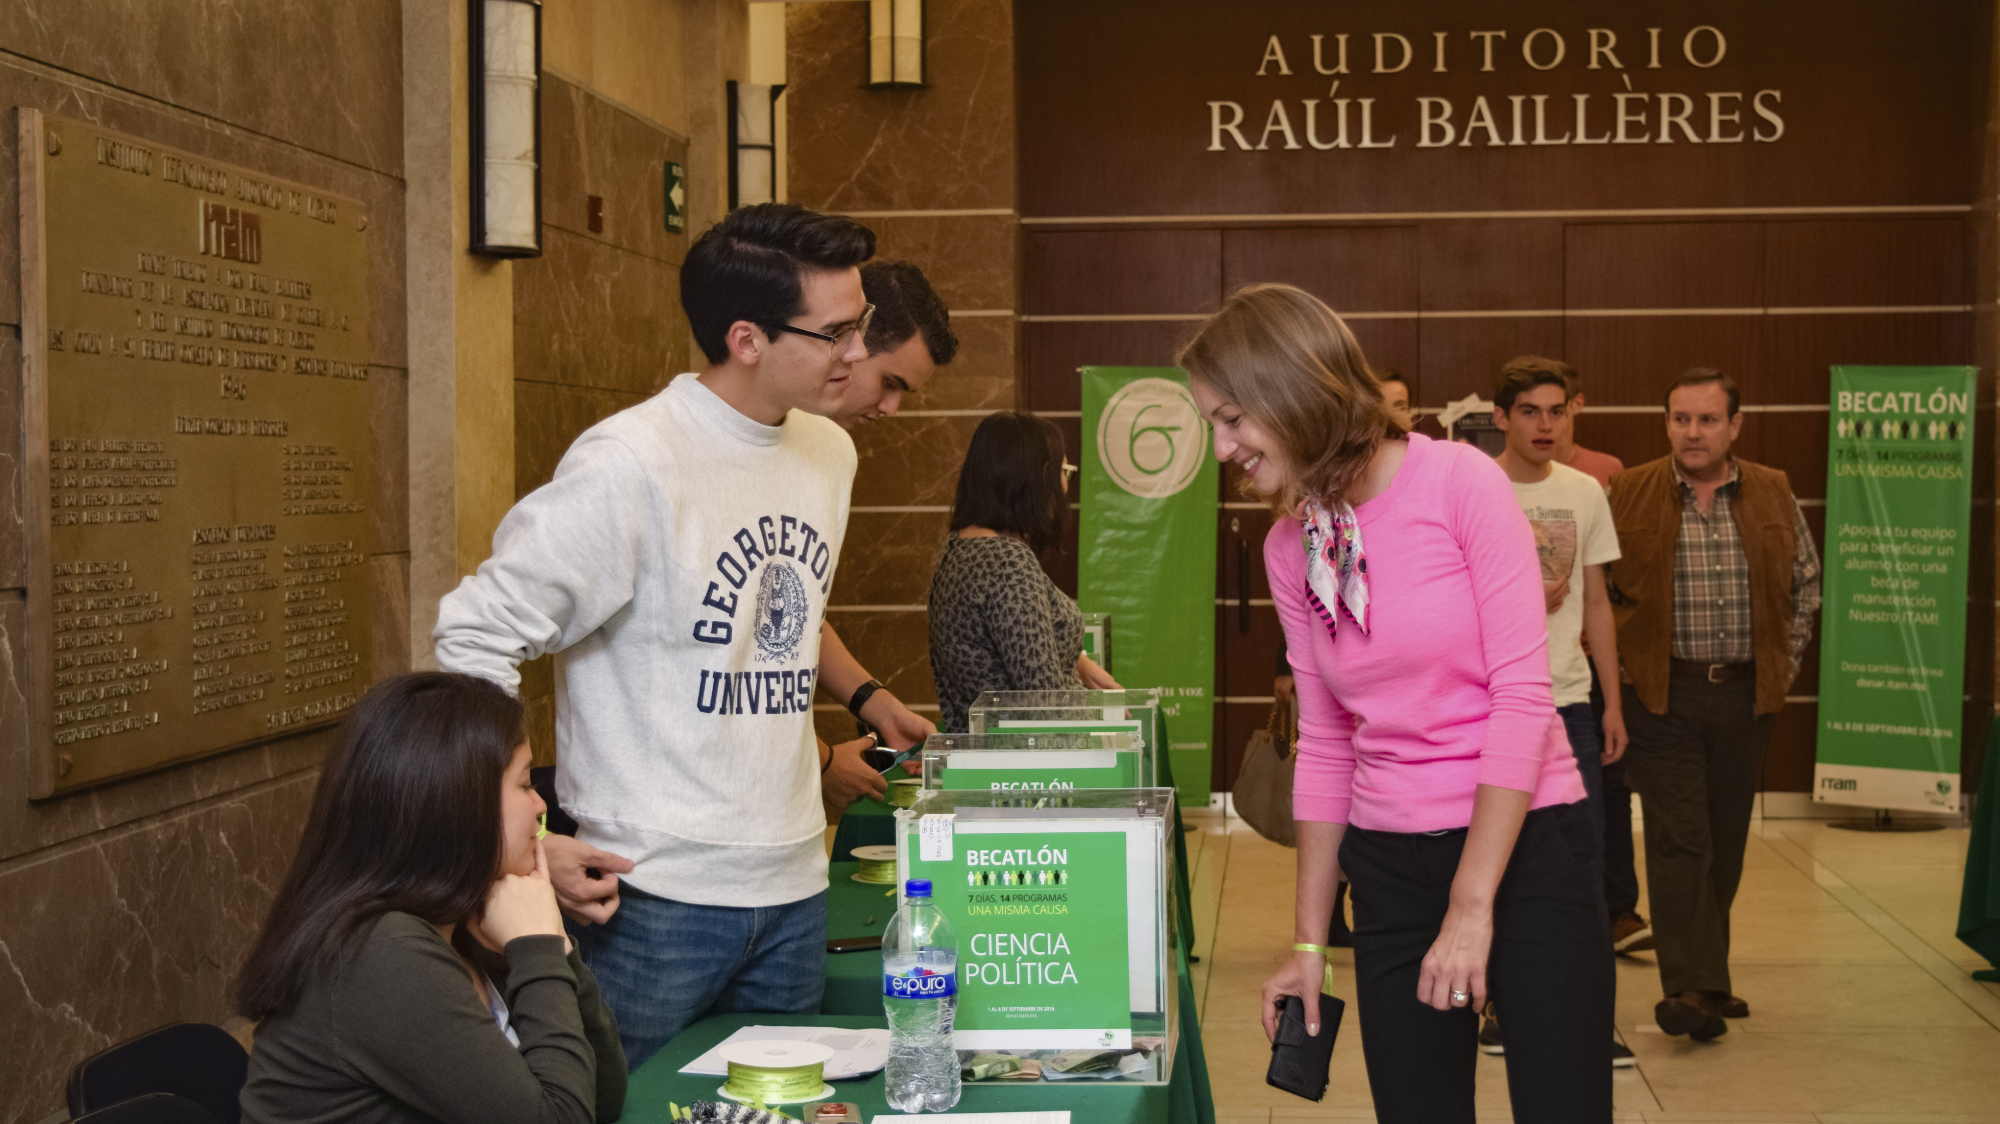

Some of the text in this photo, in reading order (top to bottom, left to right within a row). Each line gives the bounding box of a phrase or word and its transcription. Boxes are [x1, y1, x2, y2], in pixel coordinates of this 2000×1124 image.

[1255, 25, 1727, 76] AUDITORIO
[1206, 74, 1786, 152] RAÚL BAILLÈRES
[1837, 386, 1967, 414] BECATLÓN
[1834, 463, 1964, 479] UNA MISMA CAUSA
[1882, 527, 1892, 537] a
[1894, 526, 1908, 538] tu
[1910, 528, 1956, 541] equipo
[1839, 542, 1954, 556] para beneficiar un
[1845, 558, 1947, 574] alumno con una
[693, 515, 833, 645] GEORGETO
[1870, 574, 1919, 591] beca de
[1853, 593, 1936, 608] manutención
[1849, 608, 1899, 623] Nuestro
[1841, 661, 1866, 672] Dona
[697, 669, 819, 715] UNIVERS
[1852, 722, 1864, 732] DE
[1865, 723, 1918, 737] SEPTIEMBRE
[991, 778, 1074, 794] BECATLÓN
[967, 844, 1067, 866] BECATLÓN
[968, 893, 1068, 903] 7 DÍAS, 14 PROGRAMAS
[967, 904, 1069, 916] UNA MISMA CAUSA
[970, 932, 1071, 956] CIENCIA
[965, 956, 1079, 986] POLÍTICA
